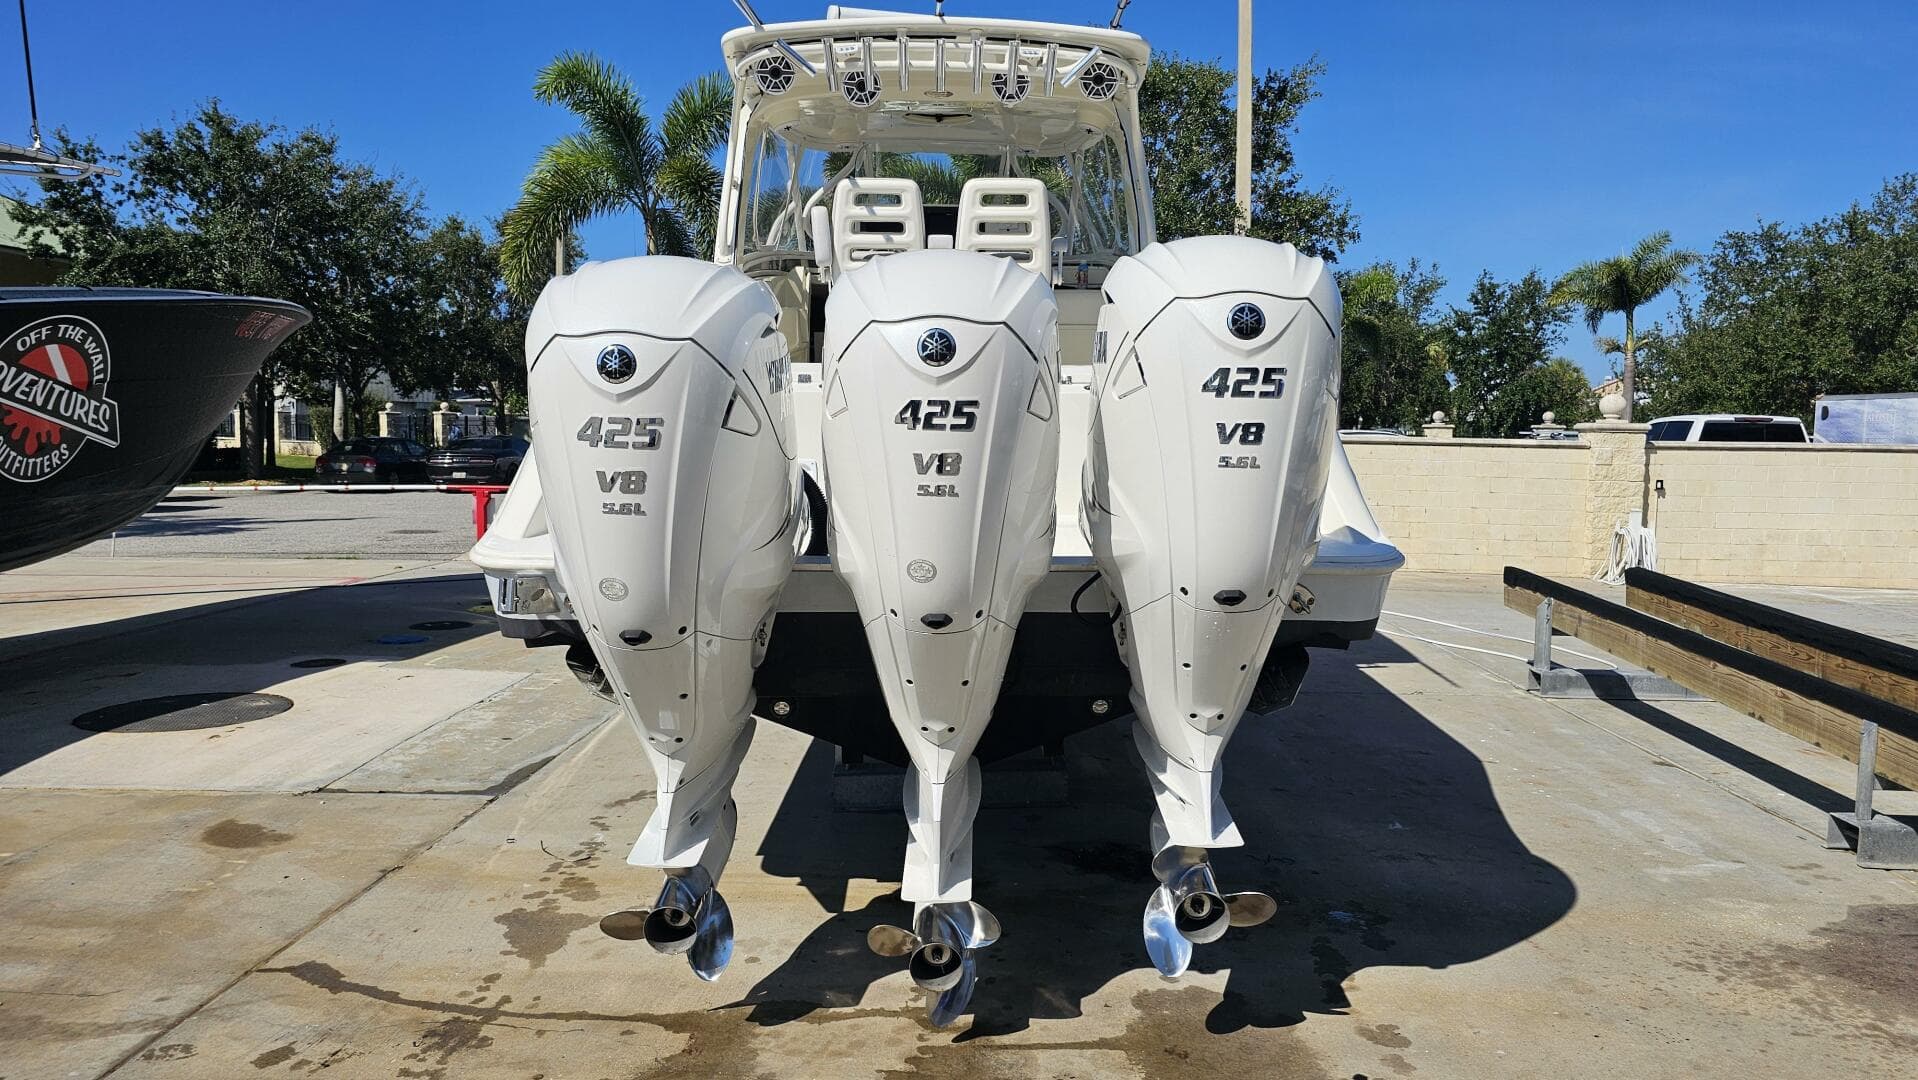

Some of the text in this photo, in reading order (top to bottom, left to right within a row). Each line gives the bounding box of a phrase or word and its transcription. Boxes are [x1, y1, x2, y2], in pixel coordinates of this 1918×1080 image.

[16, 324, 105, 385] OFF THE WALL
[1201, 367, 1287, 399] 425
[895, 400, 980, 432] 425
[577, 416, 664, 450] 425
[1216, 422, 1265, 446] V8
[912, 452, 962, 476] V8
[1217, 456, 1261, 469] 5.6L
[596, 470, 647, 495] V8
[916, 484, 959, 498] 5.6L
[602, 502, 647, 517] 5.6L
